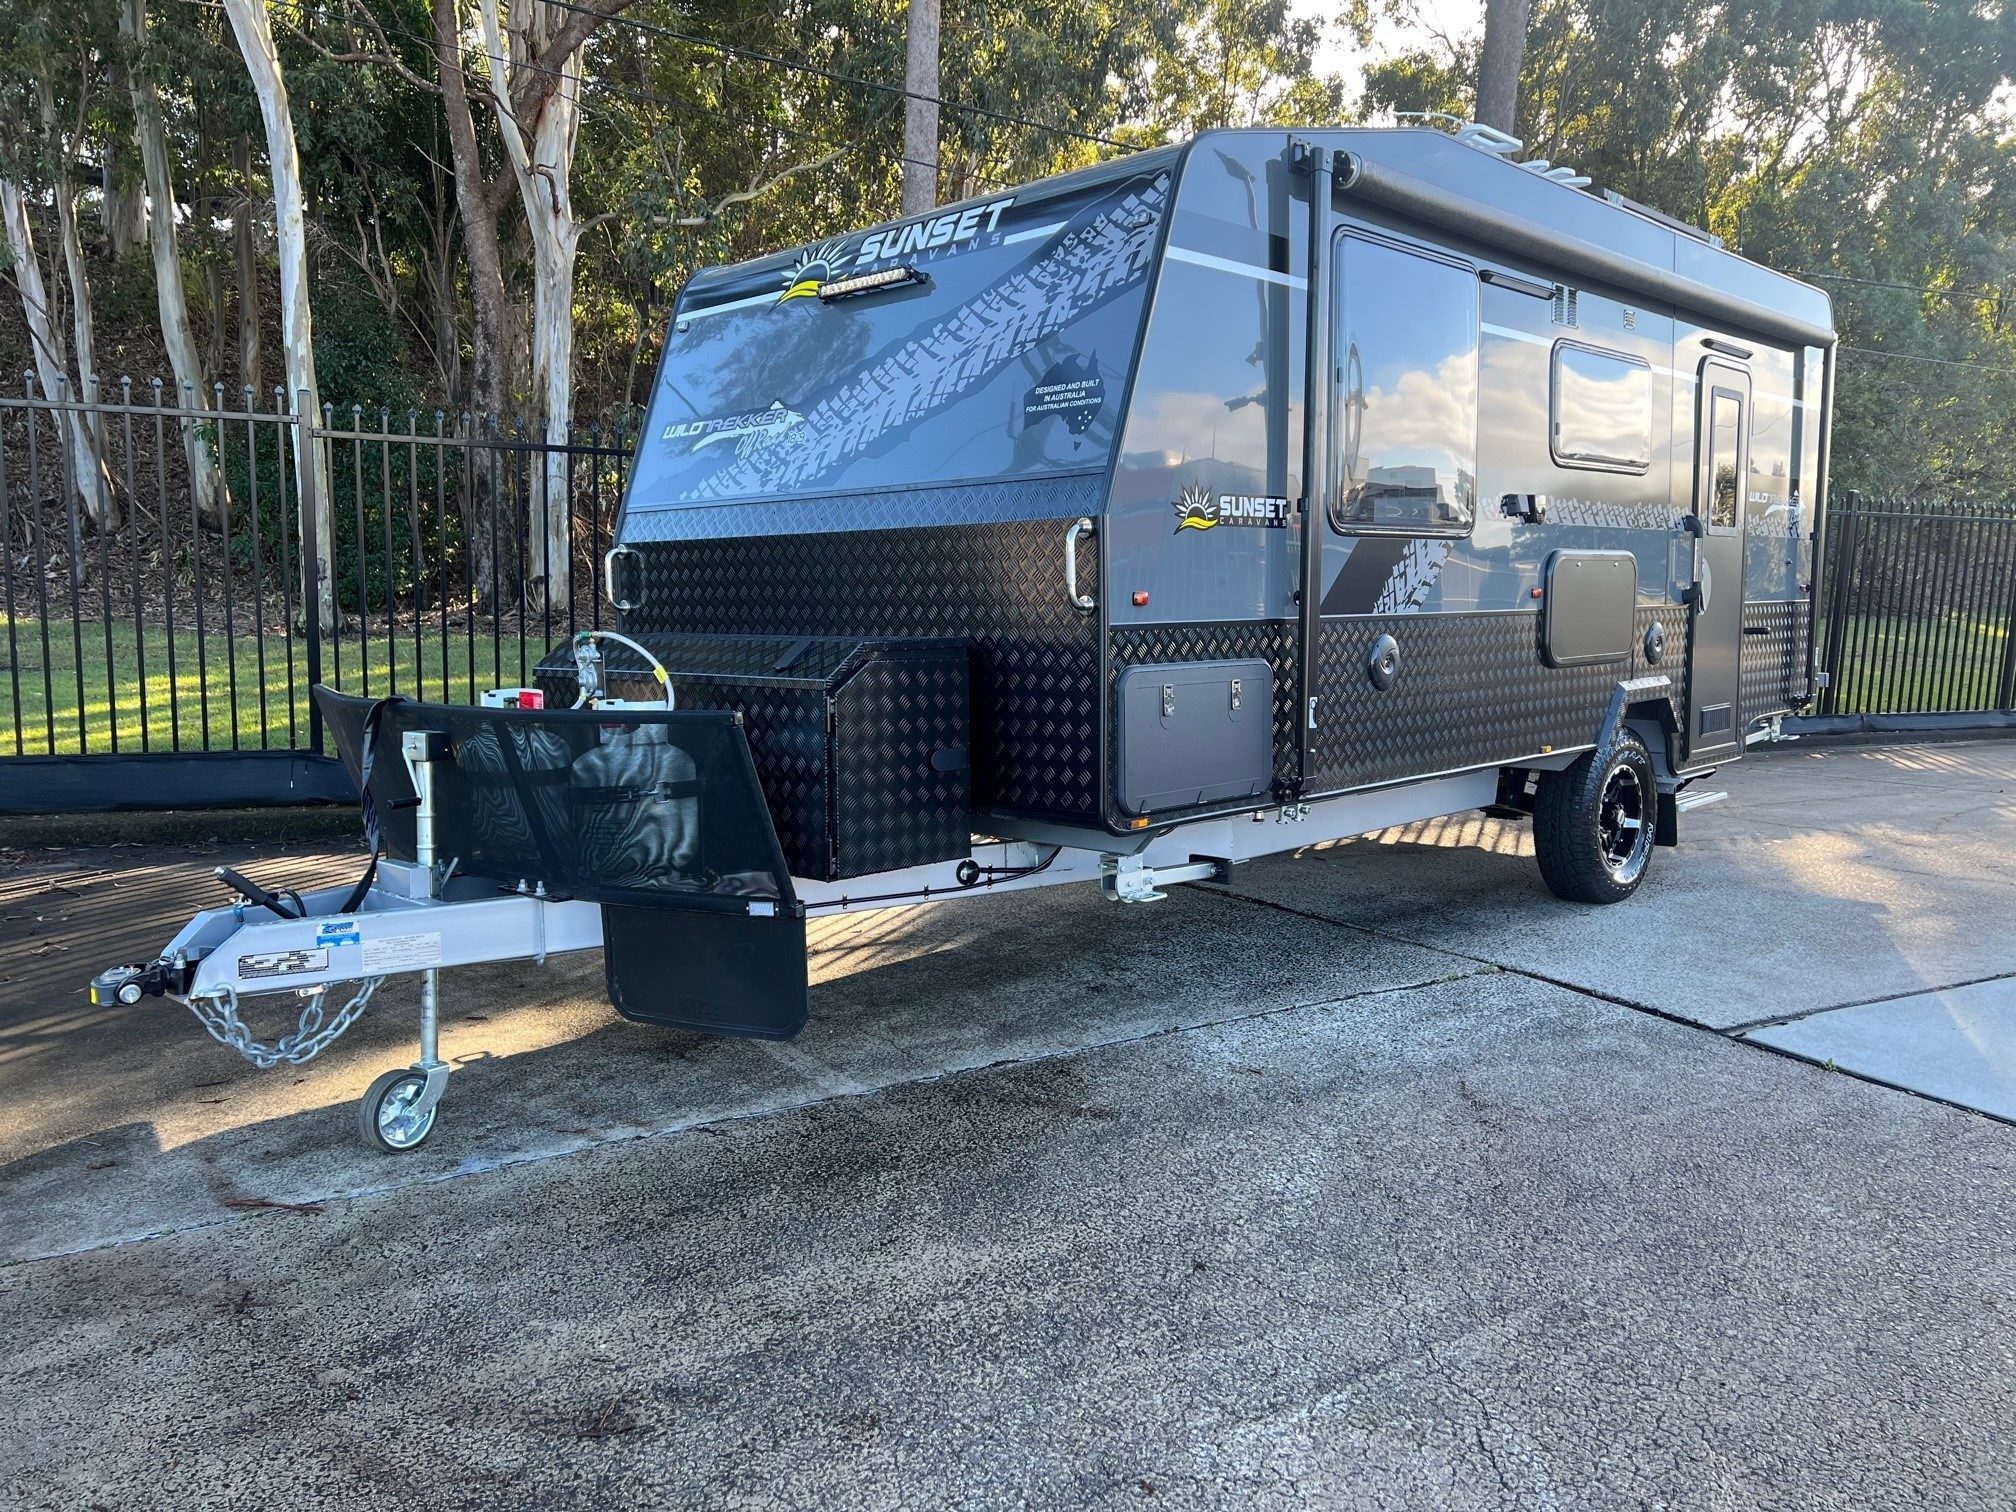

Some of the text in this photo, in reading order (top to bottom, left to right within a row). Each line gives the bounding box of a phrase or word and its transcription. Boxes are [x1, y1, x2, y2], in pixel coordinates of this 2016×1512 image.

[854, 197, 1016, 265] SUNSET
[1035, 379, 1100, 394] DESIGNED AND BUILT
[1051, 390, 1086, 400] AUSTRALIA
[1036, 402, 1069, 410] AUSTRALIAN
[1070, 397, 1101, 406] CONDITIONS
[1219, 495, 1287, 519] SUNSET
[1220, 518, 1287, 526] CARAVANS
